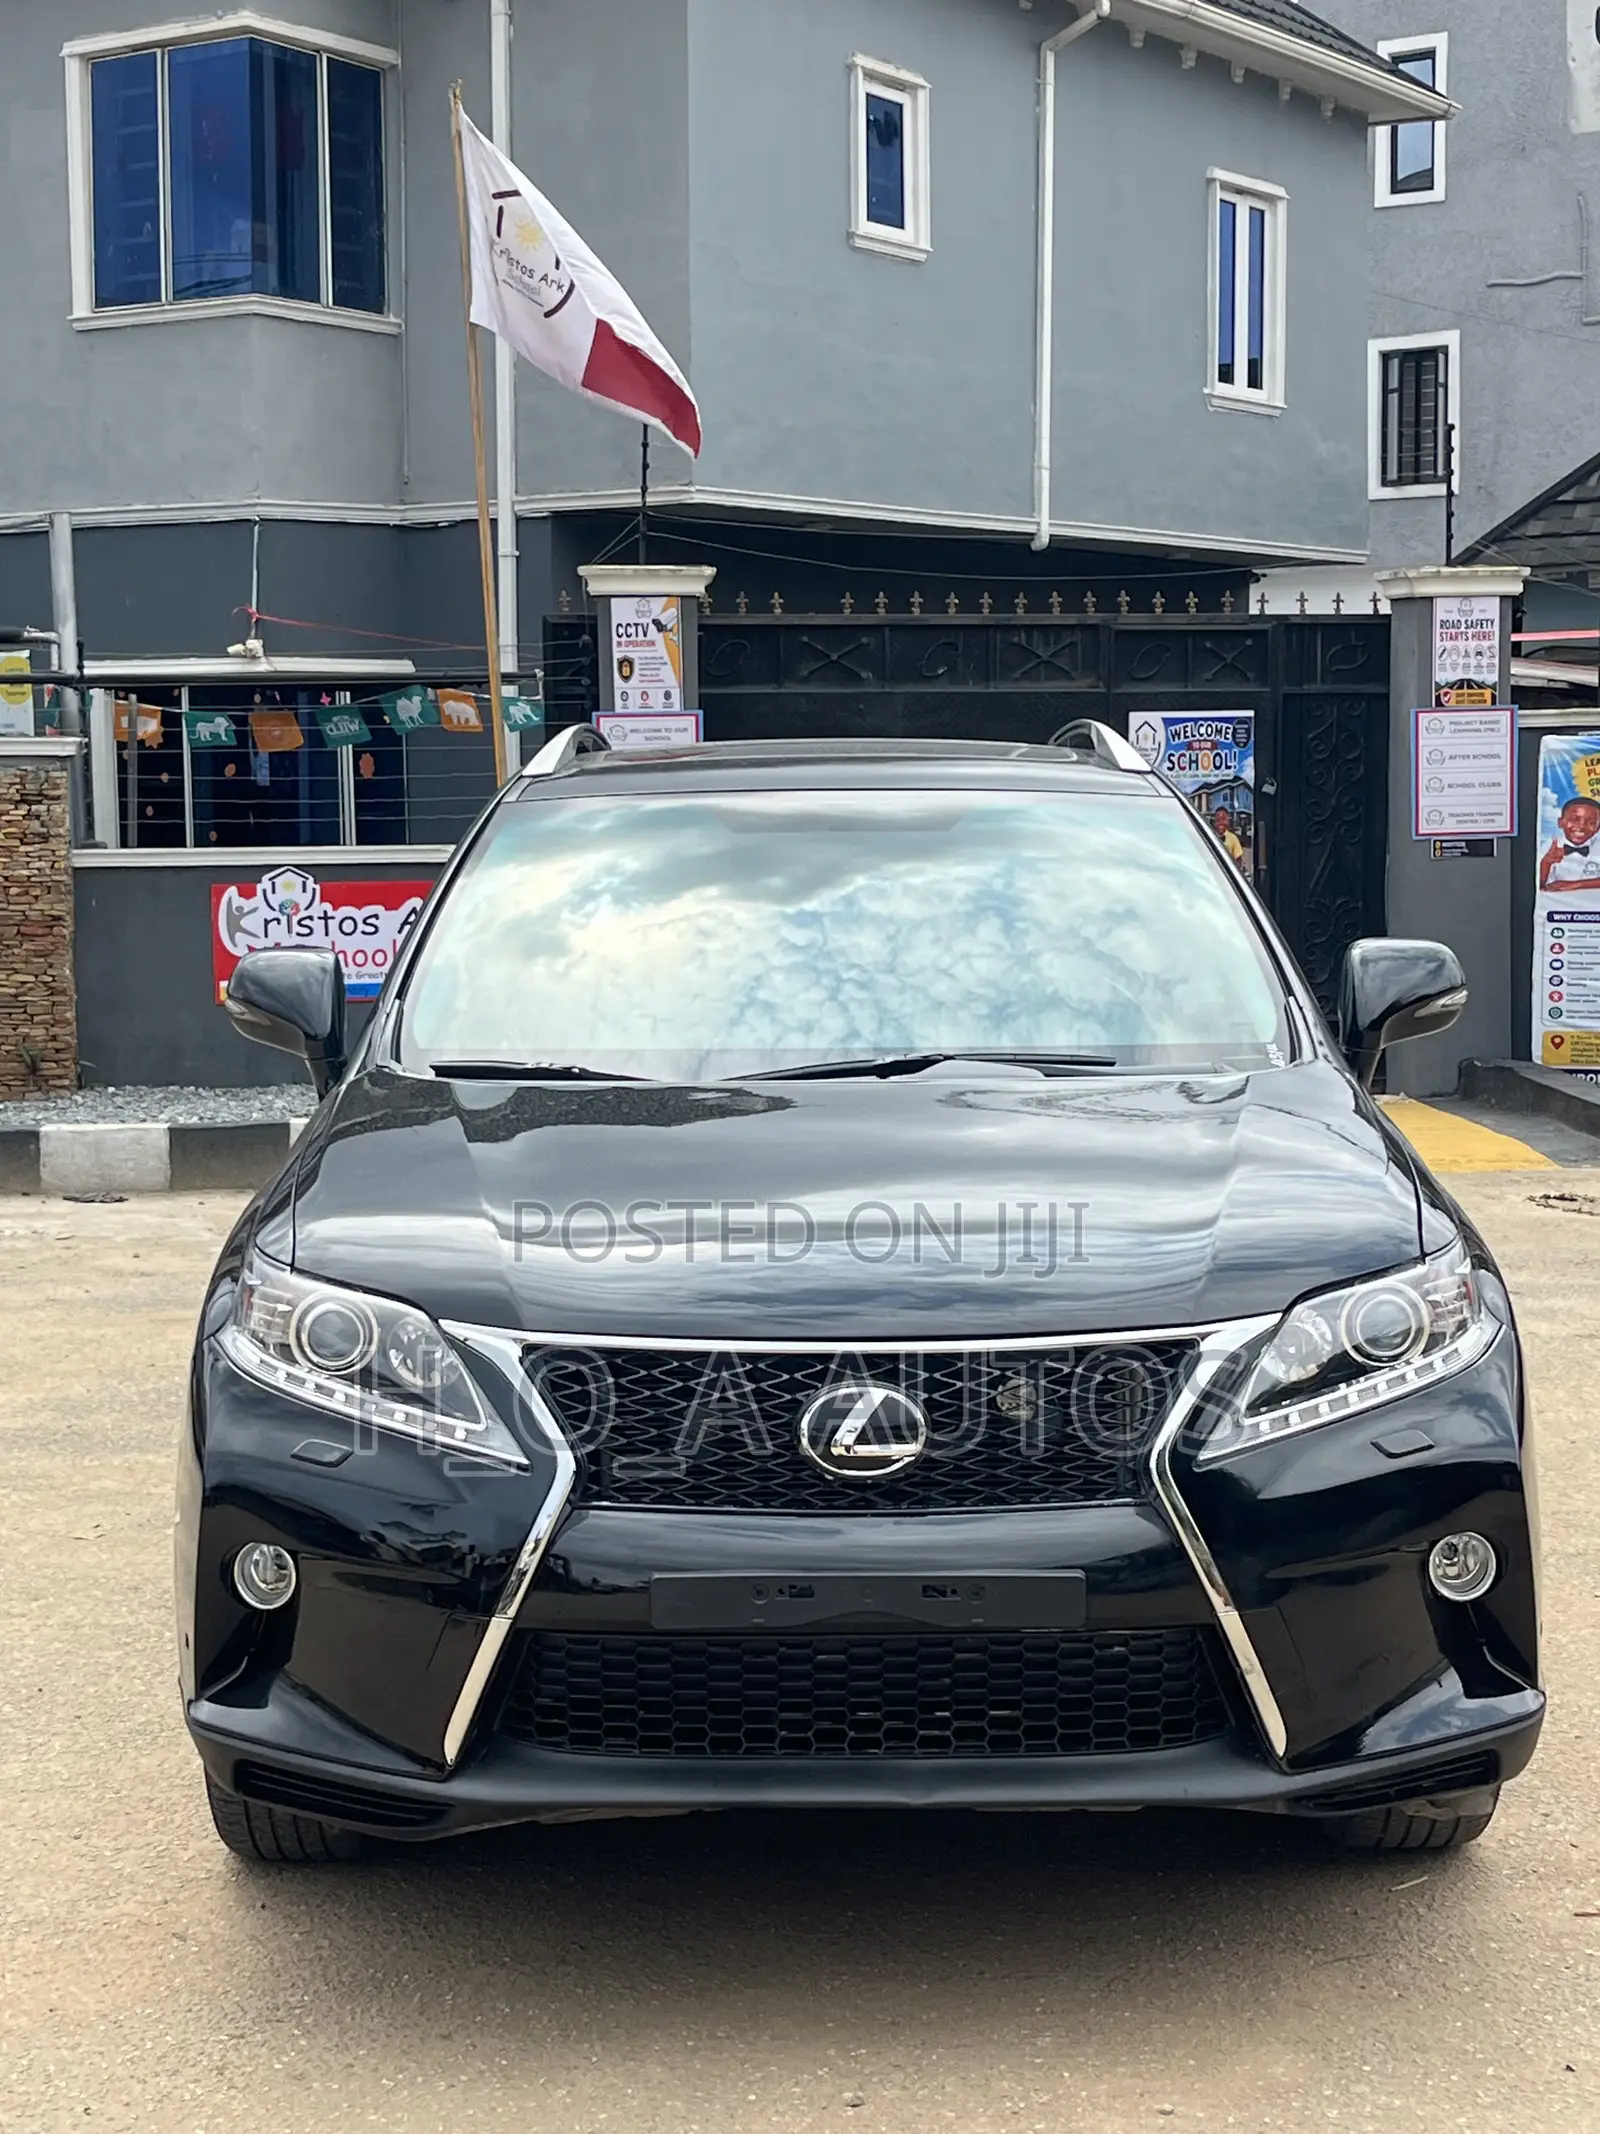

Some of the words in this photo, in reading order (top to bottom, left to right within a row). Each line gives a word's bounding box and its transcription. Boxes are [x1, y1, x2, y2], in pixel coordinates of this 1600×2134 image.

[539, 273, 565, 294] Ark
[616, 622, 649, 638] CCTV
[1440, 619, 1462, 630] ROAD
[1463, 618, 1495, 629] SAFETY
[1440, 631, 1469, 642] STARTS
[1471, 631, 1495, 641] HERE!
[623, 640, 656, 648] OPERATION
[1168, 722, 1233, 743] WELCOME
[1166, 750, 1238, 772] SCHOOL!
[1553, 913, 1572, 921] WHY
